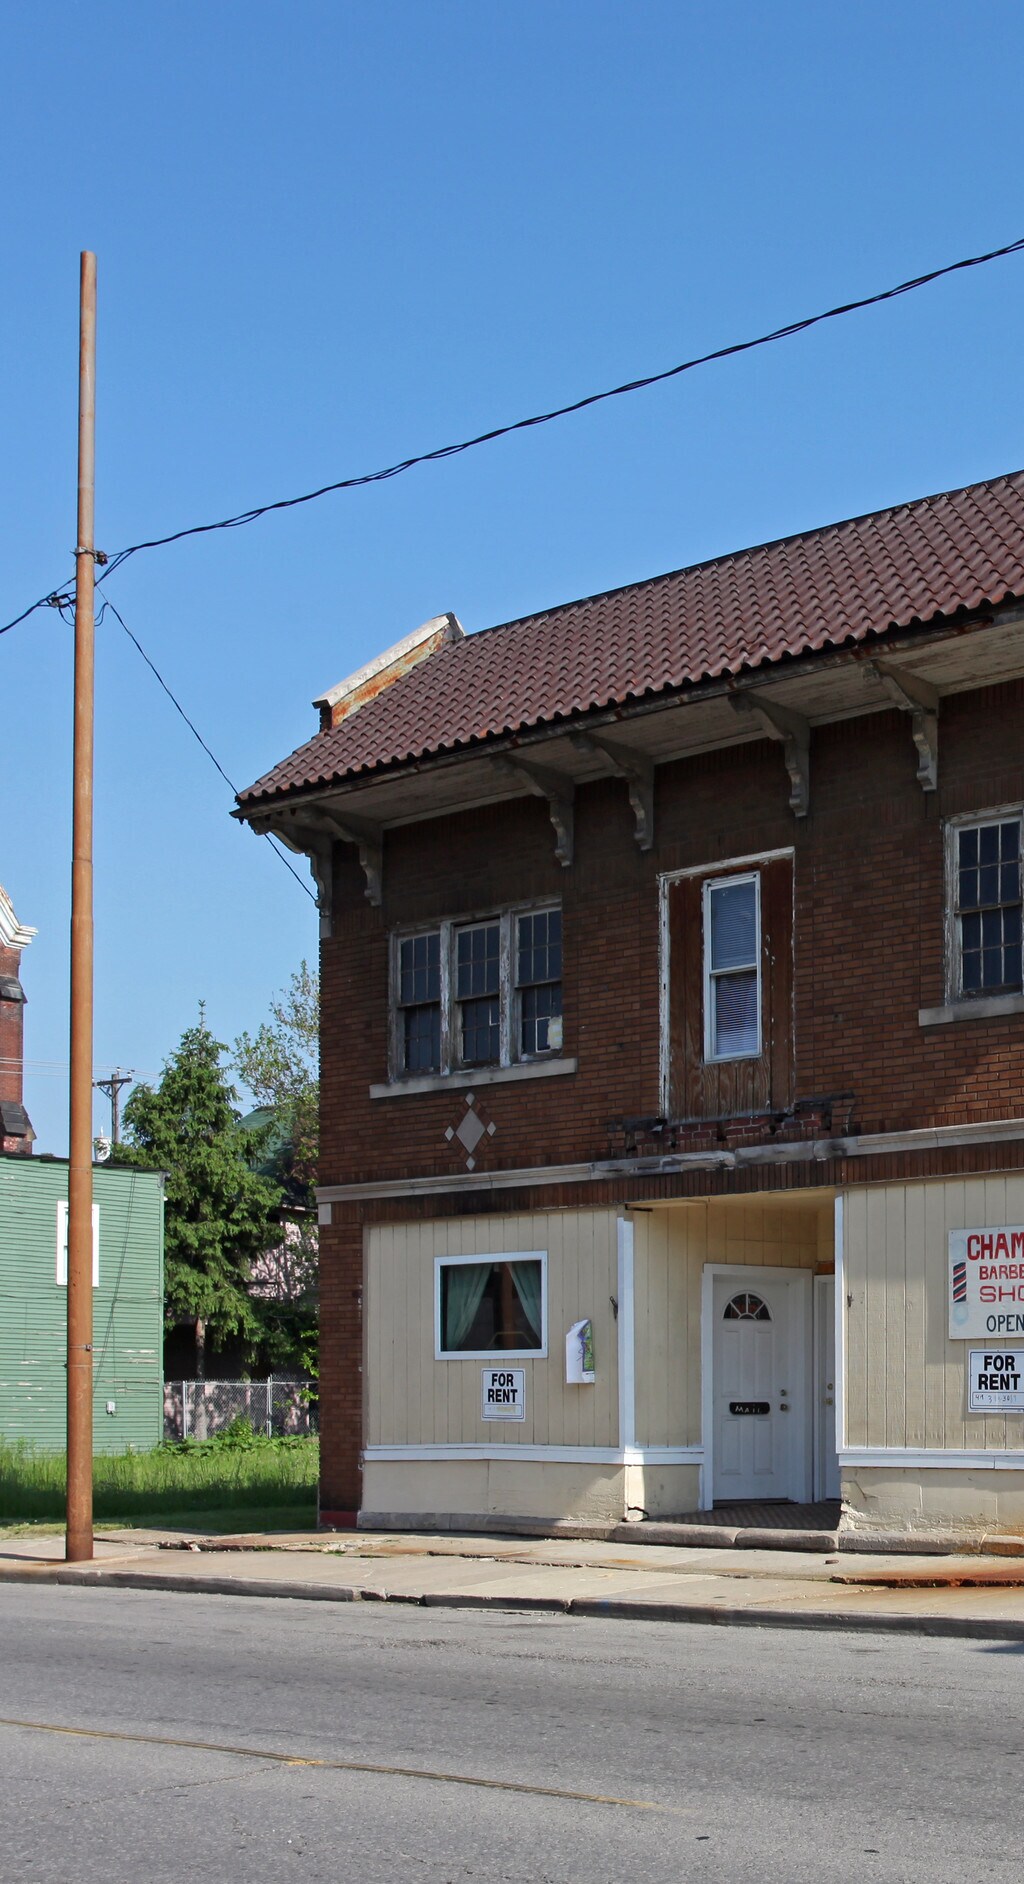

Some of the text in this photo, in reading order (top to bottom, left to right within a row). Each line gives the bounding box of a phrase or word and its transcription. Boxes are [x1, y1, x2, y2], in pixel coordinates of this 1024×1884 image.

[984, 1355, 1015, 1371] FOR
[491, 1373, 514, 1387] FOR
[978, 1373, 1021, 1390] RENT
[487, 1389, 518, 1403] RENT
